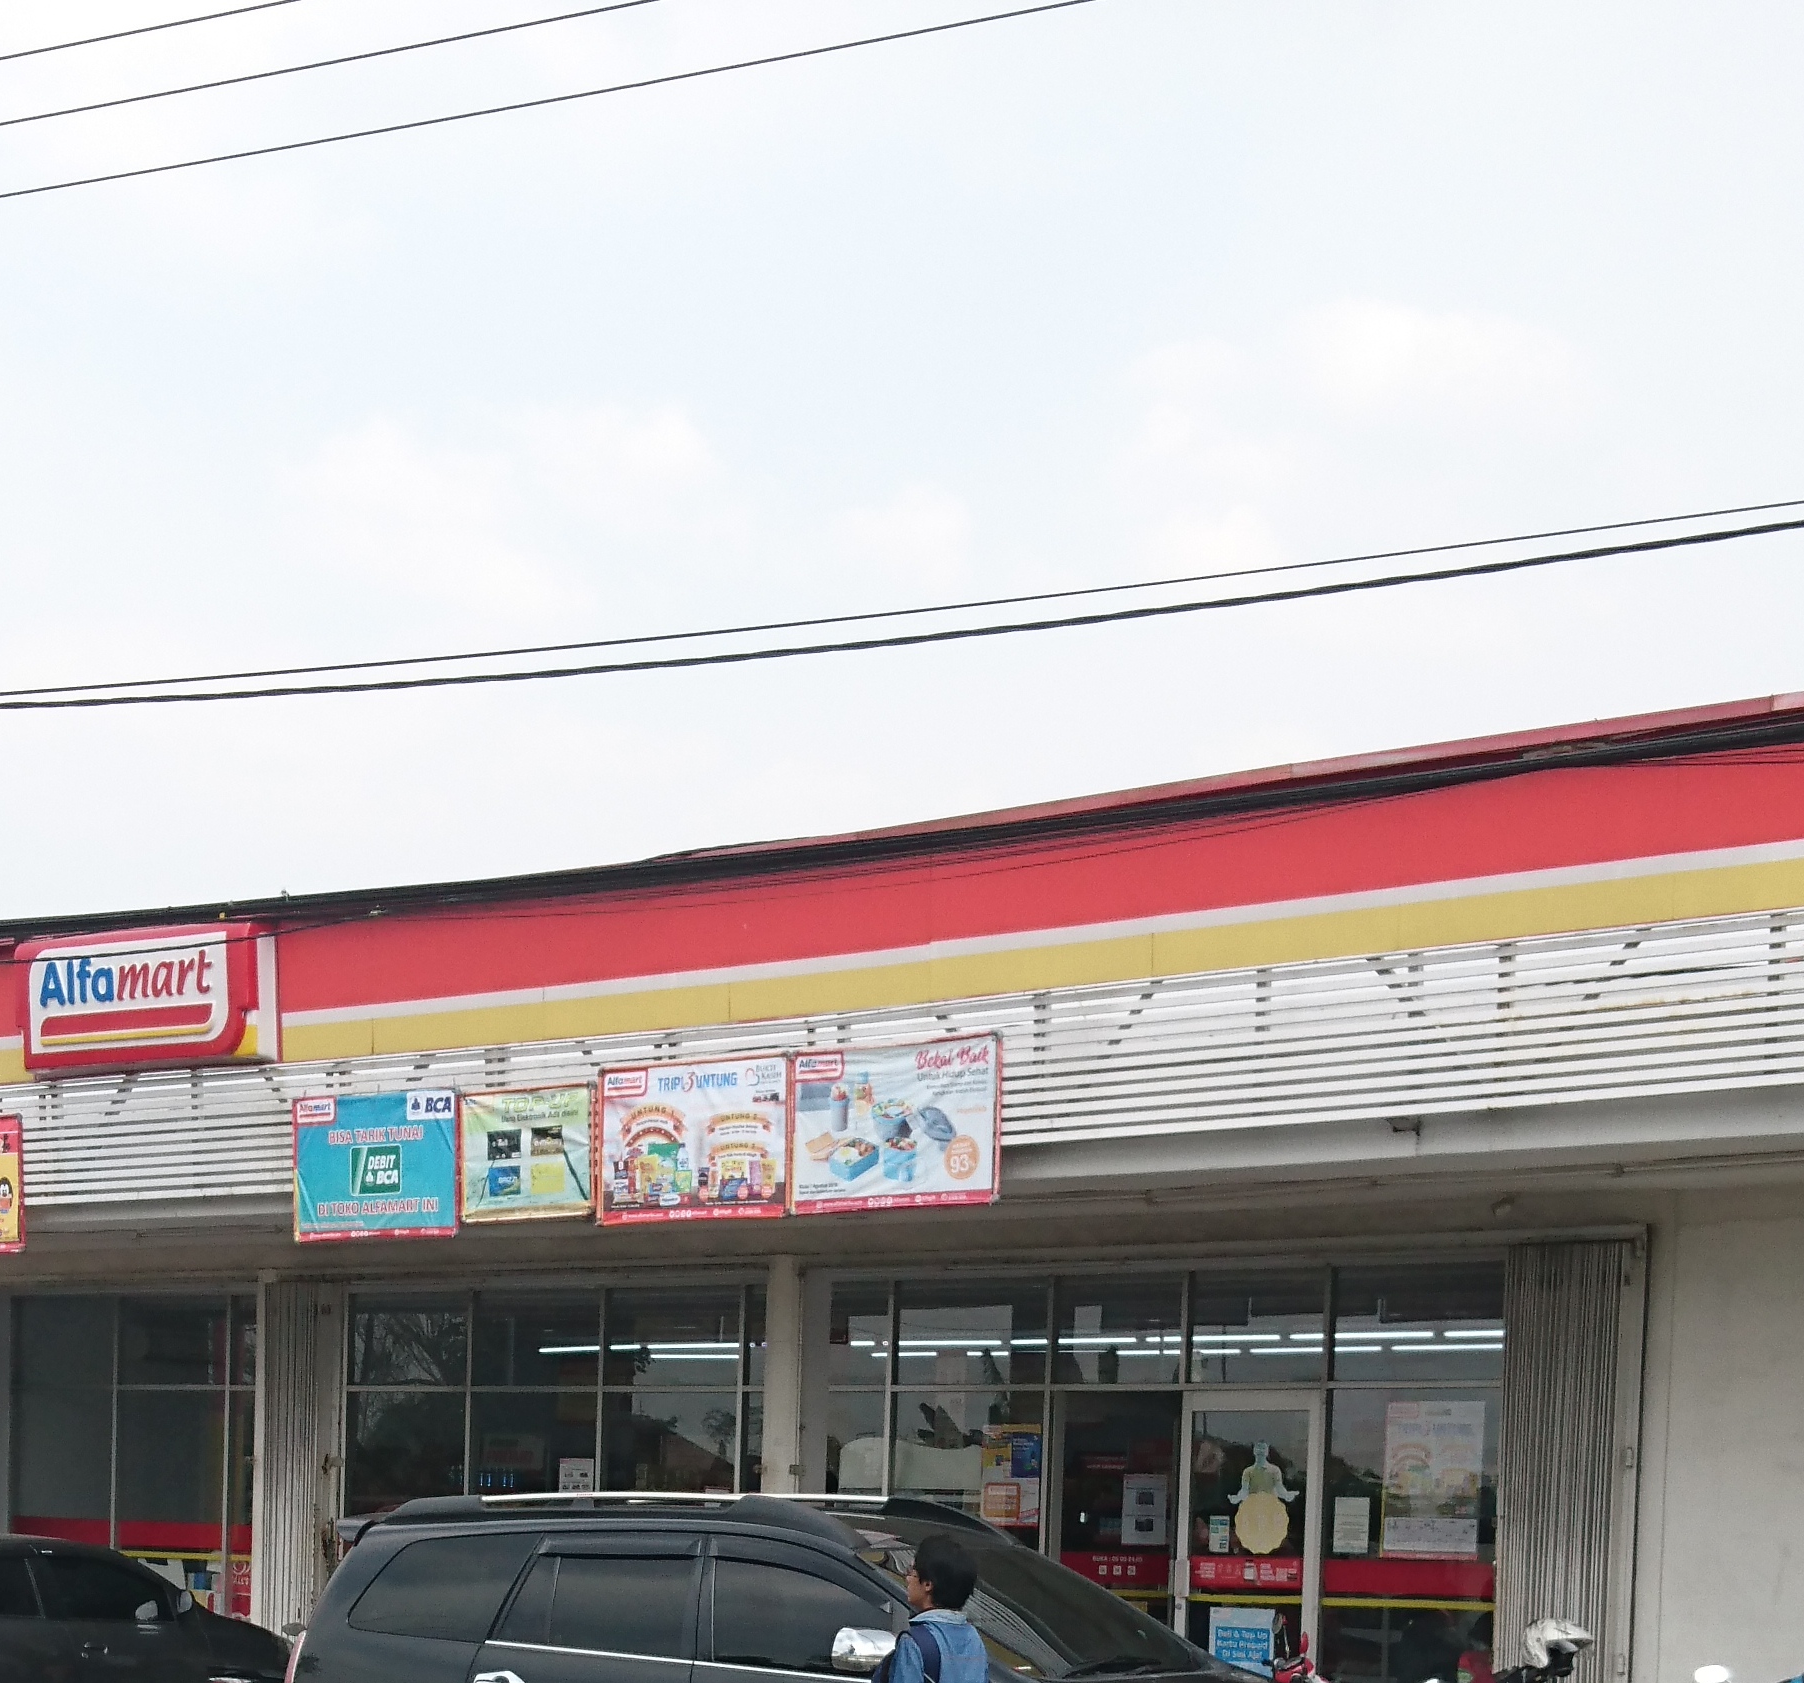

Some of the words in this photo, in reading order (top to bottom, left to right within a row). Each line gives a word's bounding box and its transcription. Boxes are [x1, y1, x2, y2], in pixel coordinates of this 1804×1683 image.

[39, 949, 213, 1008] Alfamart
[607, 1075, 643, 1086] Alfamart
[299, 1102, 331, 1112] Alfamart
[424, 1096, 452, 1113] BCA
[329, 1131, 353, 1145] BISA
[354, 1128, 387, 1144] TARIK
[387, 1125, 424, 1142] TUNAI
[367, 1154, 396, 1170] DEBIT
[375, 1170, 399, 1185] BCA
[317, 1203, 329, 1216] DI
[331, 1201, 359, 1216] TOKO
[361, 1198, 419, 1214] ALFAMART
[422, 1196, 439, 1212] INI
